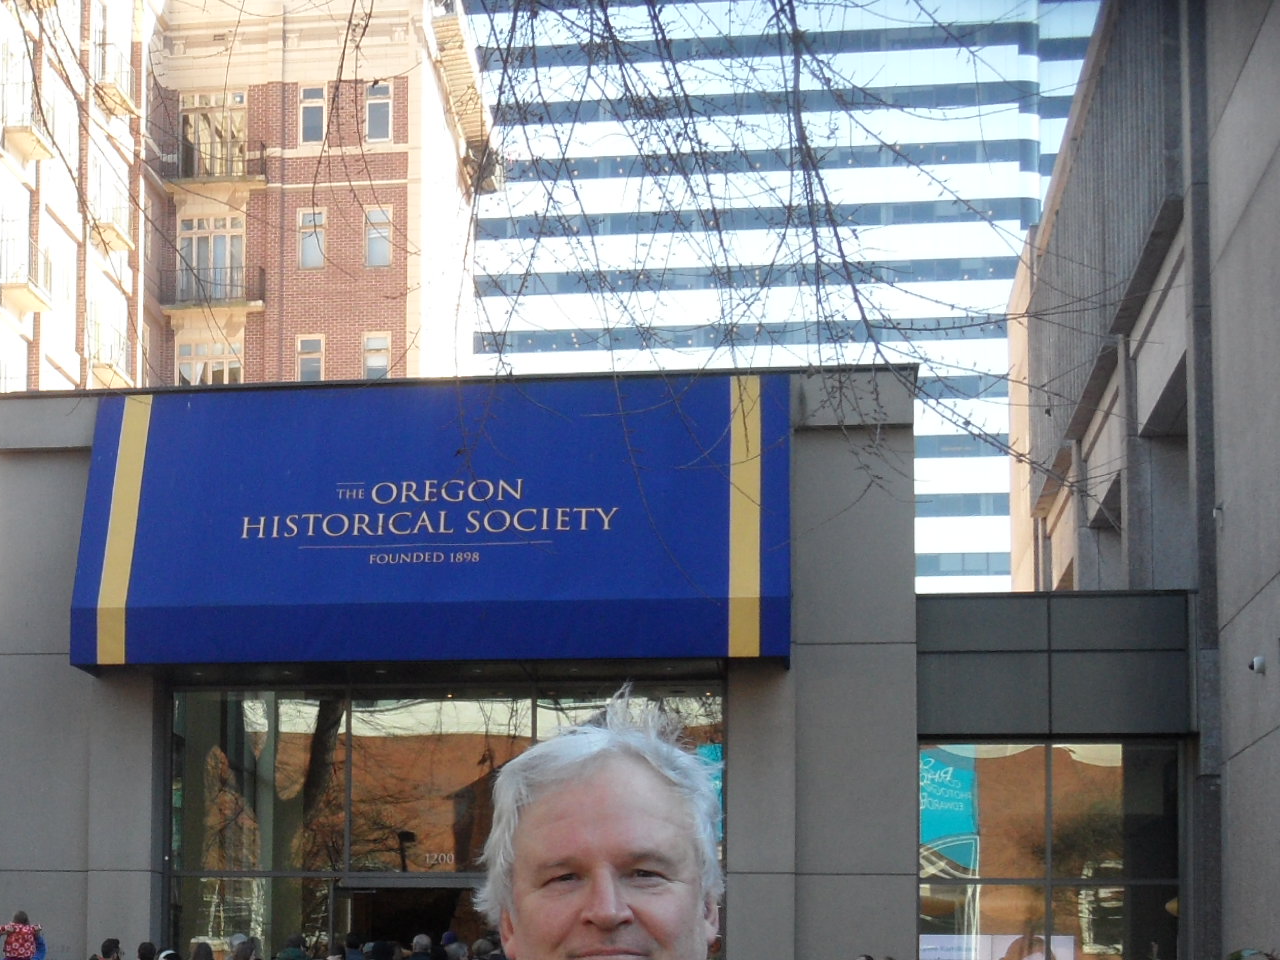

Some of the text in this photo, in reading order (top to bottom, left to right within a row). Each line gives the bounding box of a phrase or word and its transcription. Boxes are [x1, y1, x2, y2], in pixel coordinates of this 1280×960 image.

[336, 478, 524, 504] THE OREGON
[240, 507, 619, 539] HISTORICAL SOCIETY
[369, 552, 480, 564] FOUNDED 1898
[425, 853, 455, 865] 1200
